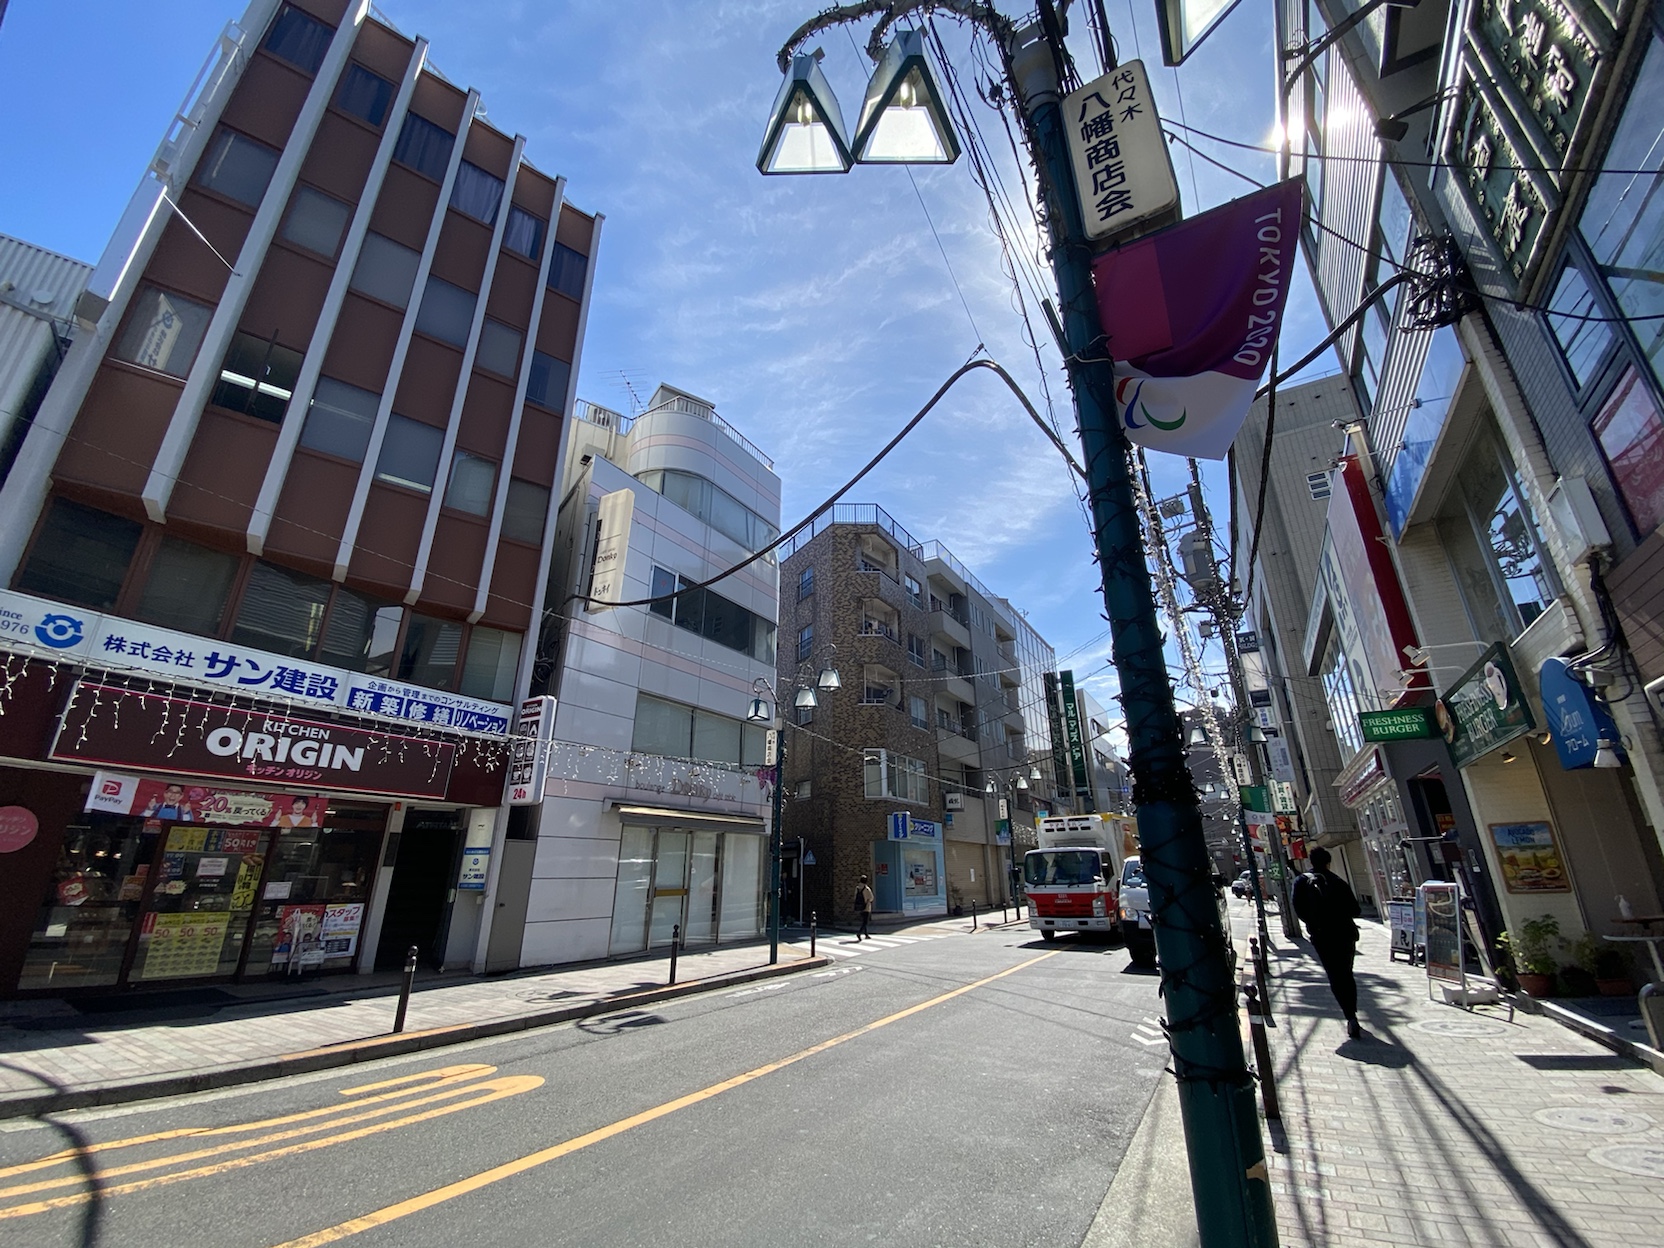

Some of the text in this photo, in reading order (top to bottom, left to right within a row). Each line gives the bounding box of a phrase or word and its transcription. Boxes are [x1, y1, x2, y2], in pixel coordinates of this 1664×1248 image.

[1112, 70, 1143, 124] 代々木
[1079, 92, 1134, 222] 八幡商店会
[1233, 207, 1284, 367] TOKYO 2020
[0, 606, 23, 620] ince
[0, 619, 30, 635] 976
[103, 634, 339, 701] 株式会社 サン建設
[367, 680, 500, 716] 企画から管理までのコンサルティング
[352, 689, 507, 734] 新築 修繕 リノベーション
[521, 706, 542, 716] ORIGIN
[1361, 713, 1425, 728] FRESHNESS
[1465, 707, 1498, 743] BURGER
[264, 719, 331, 741] KITCHEN
[1372, 723, 1420, 736] BURGER
[205, 726, 365, 773] ORIGIN
[1564, 734, 1590, 754] アローム
[246, 764, 322, 780] キッチン オリジン
[94, 794, 123, 805] PayPay
[512, 788, 527, 800] 24h
[0, 824, 32, 836] リジン
[1511, 836, 1536, 845] LEMON
[154, 926, 218, 939] 50 50 50
